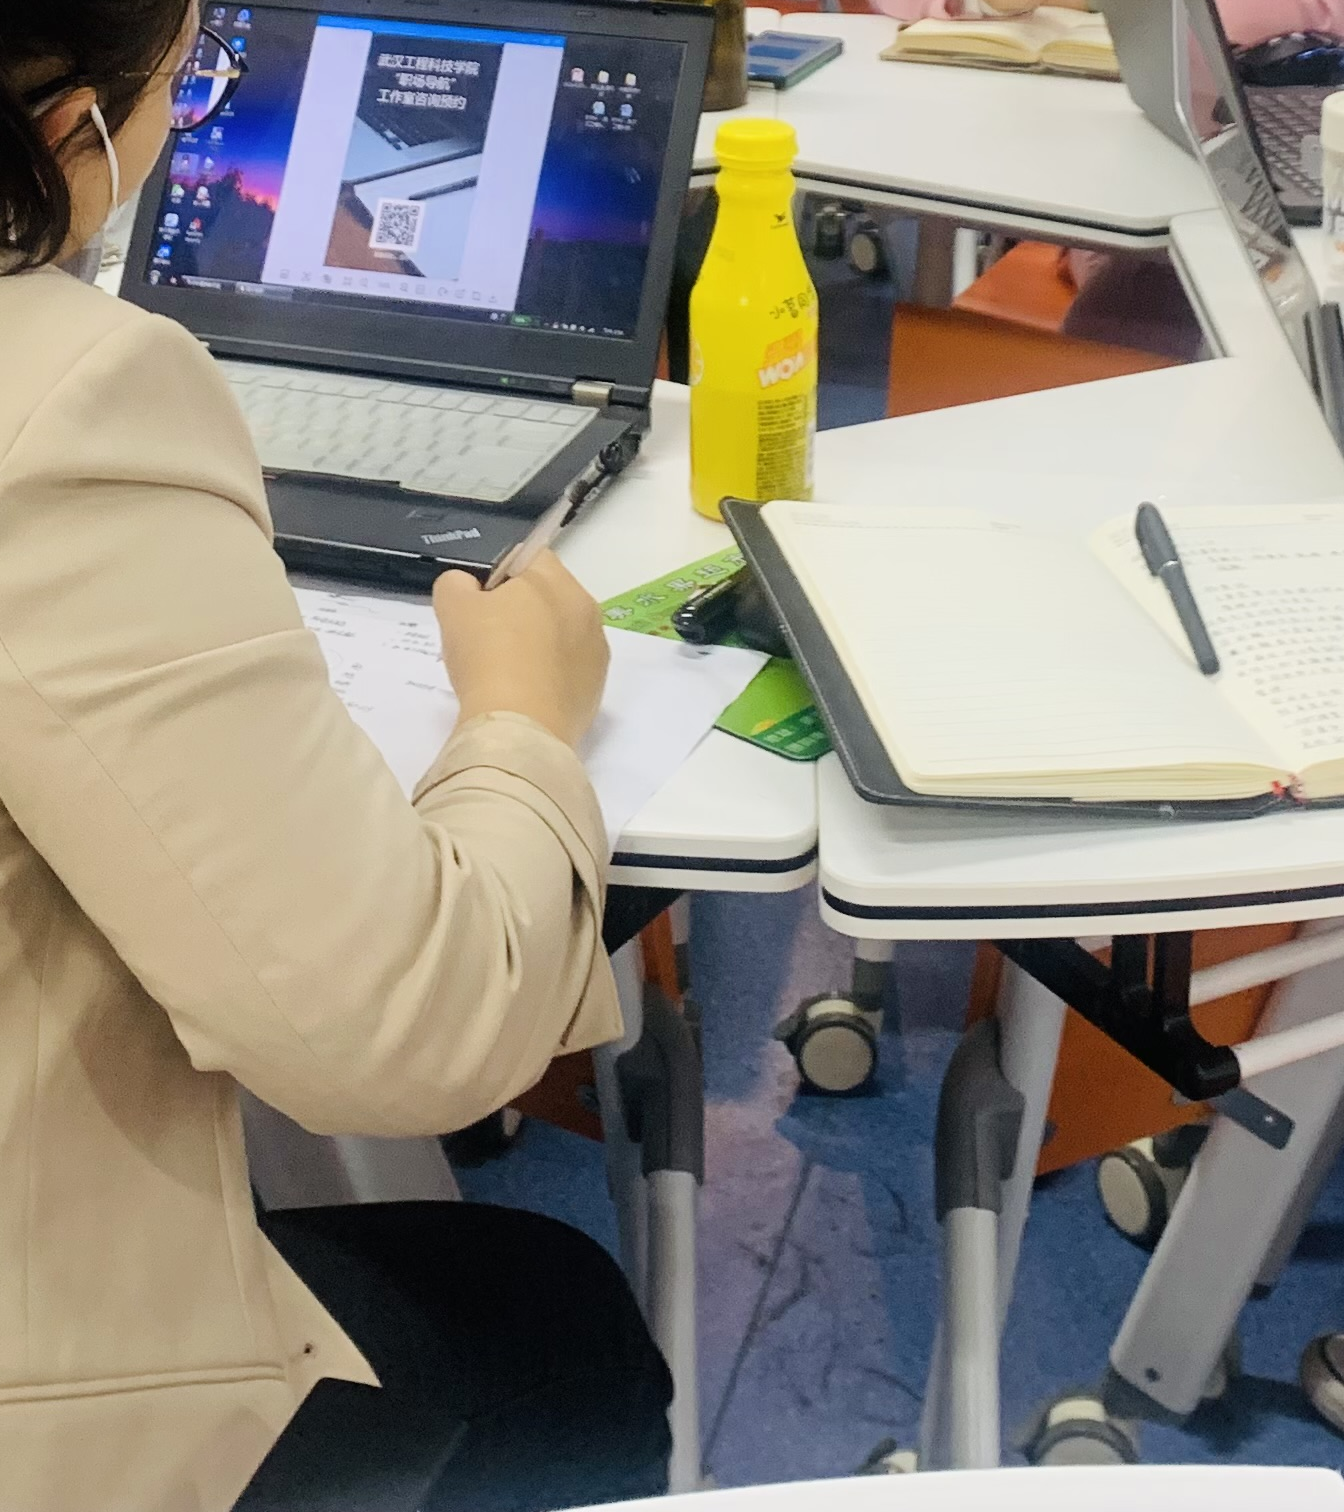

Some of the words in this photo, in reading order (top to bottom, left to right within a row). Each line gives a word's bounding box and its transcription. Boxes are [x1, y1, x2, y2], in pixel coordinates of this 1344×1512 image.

[377, 53, 481, 76] 武汉工程科技学院
[376, 89, 467, 110] 工作室咨询预约
[420, 528, 481, 545] ThinkPad
